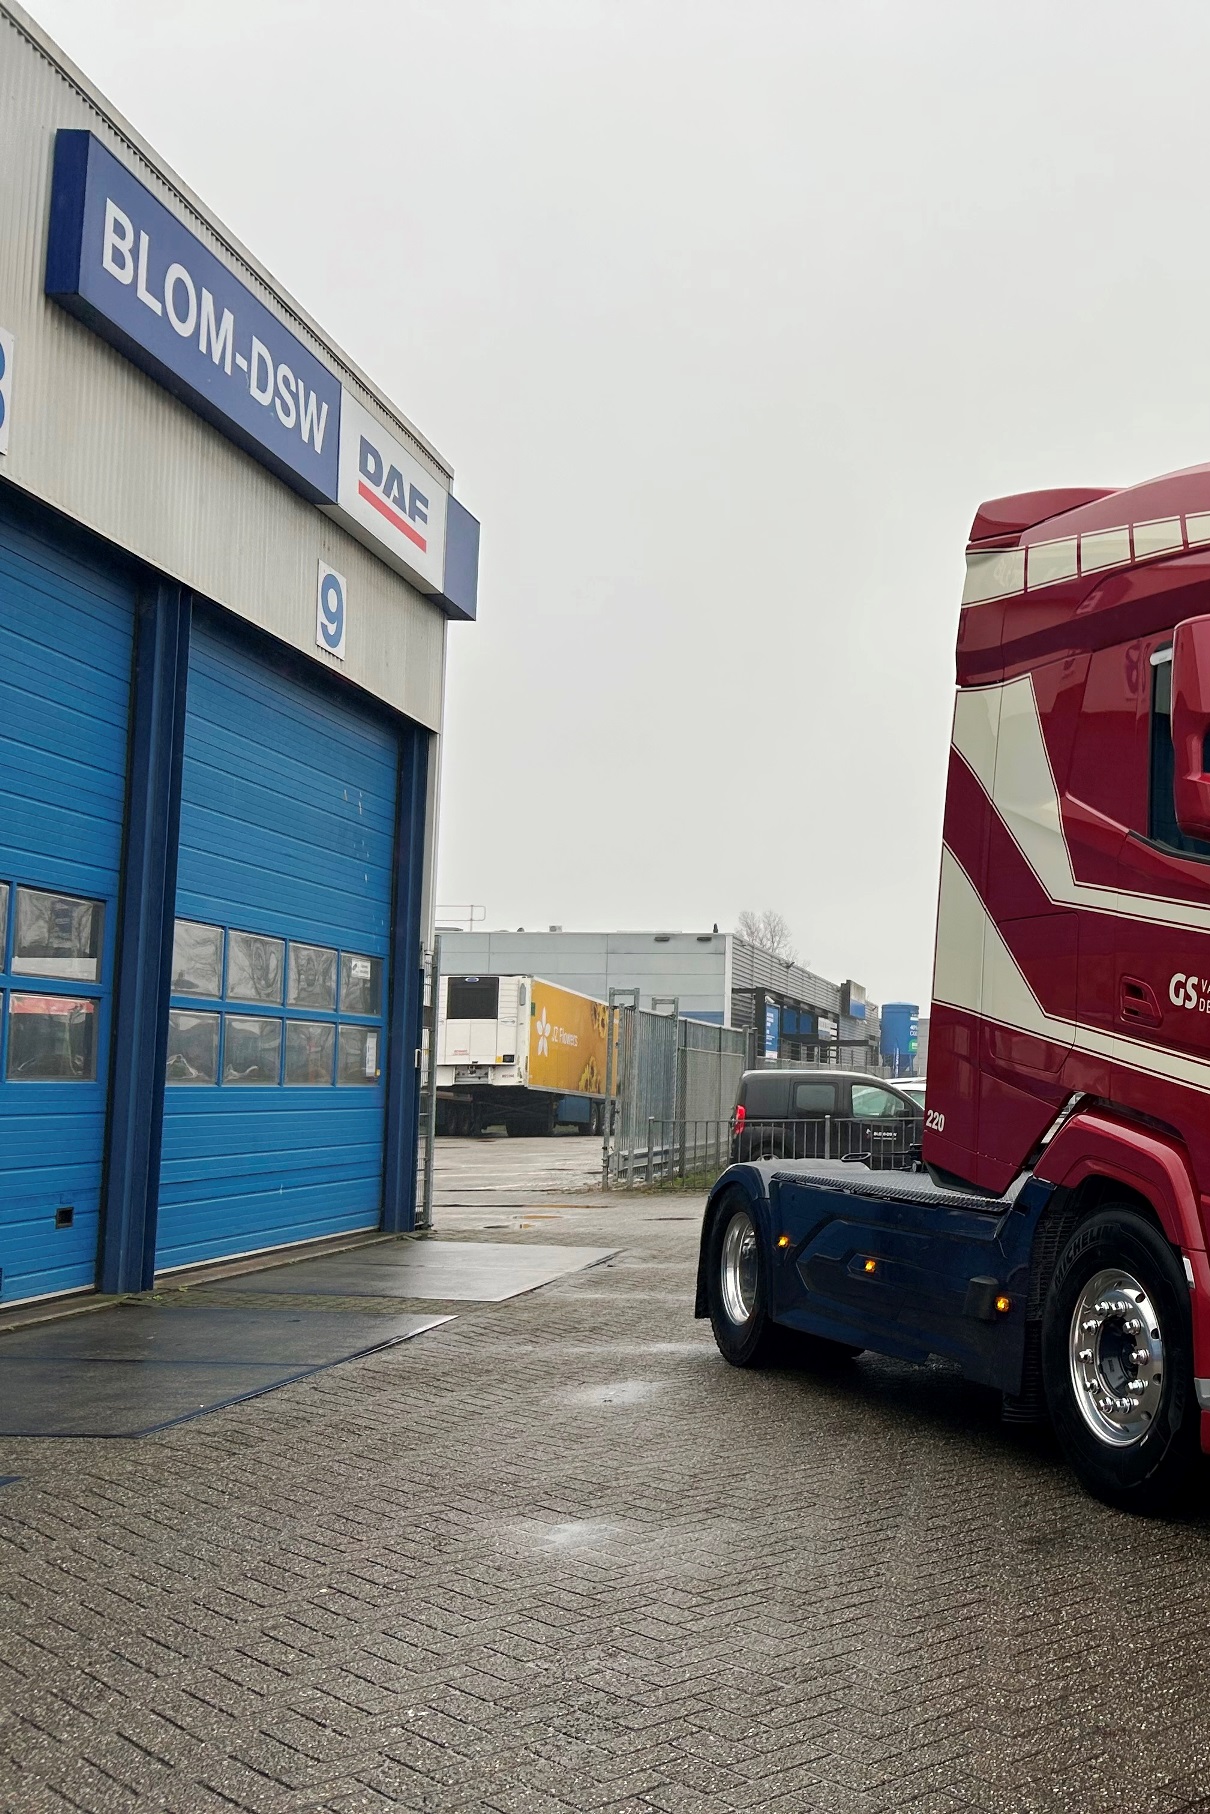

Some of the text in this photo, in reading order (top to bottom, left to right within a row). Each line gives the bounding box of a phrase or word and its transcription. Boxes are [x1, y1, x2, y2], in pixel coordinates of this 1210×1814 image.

[102, 196, 328, 455] BLOM-DSW
[358, 434, 429, 525] DAF
[320, 573, 344, 648] 9
[1169, 973, 1198, 1009] GS
[559, 1027, 578, 1047] Flowers
[926, 1109, 945, 1132] 220
